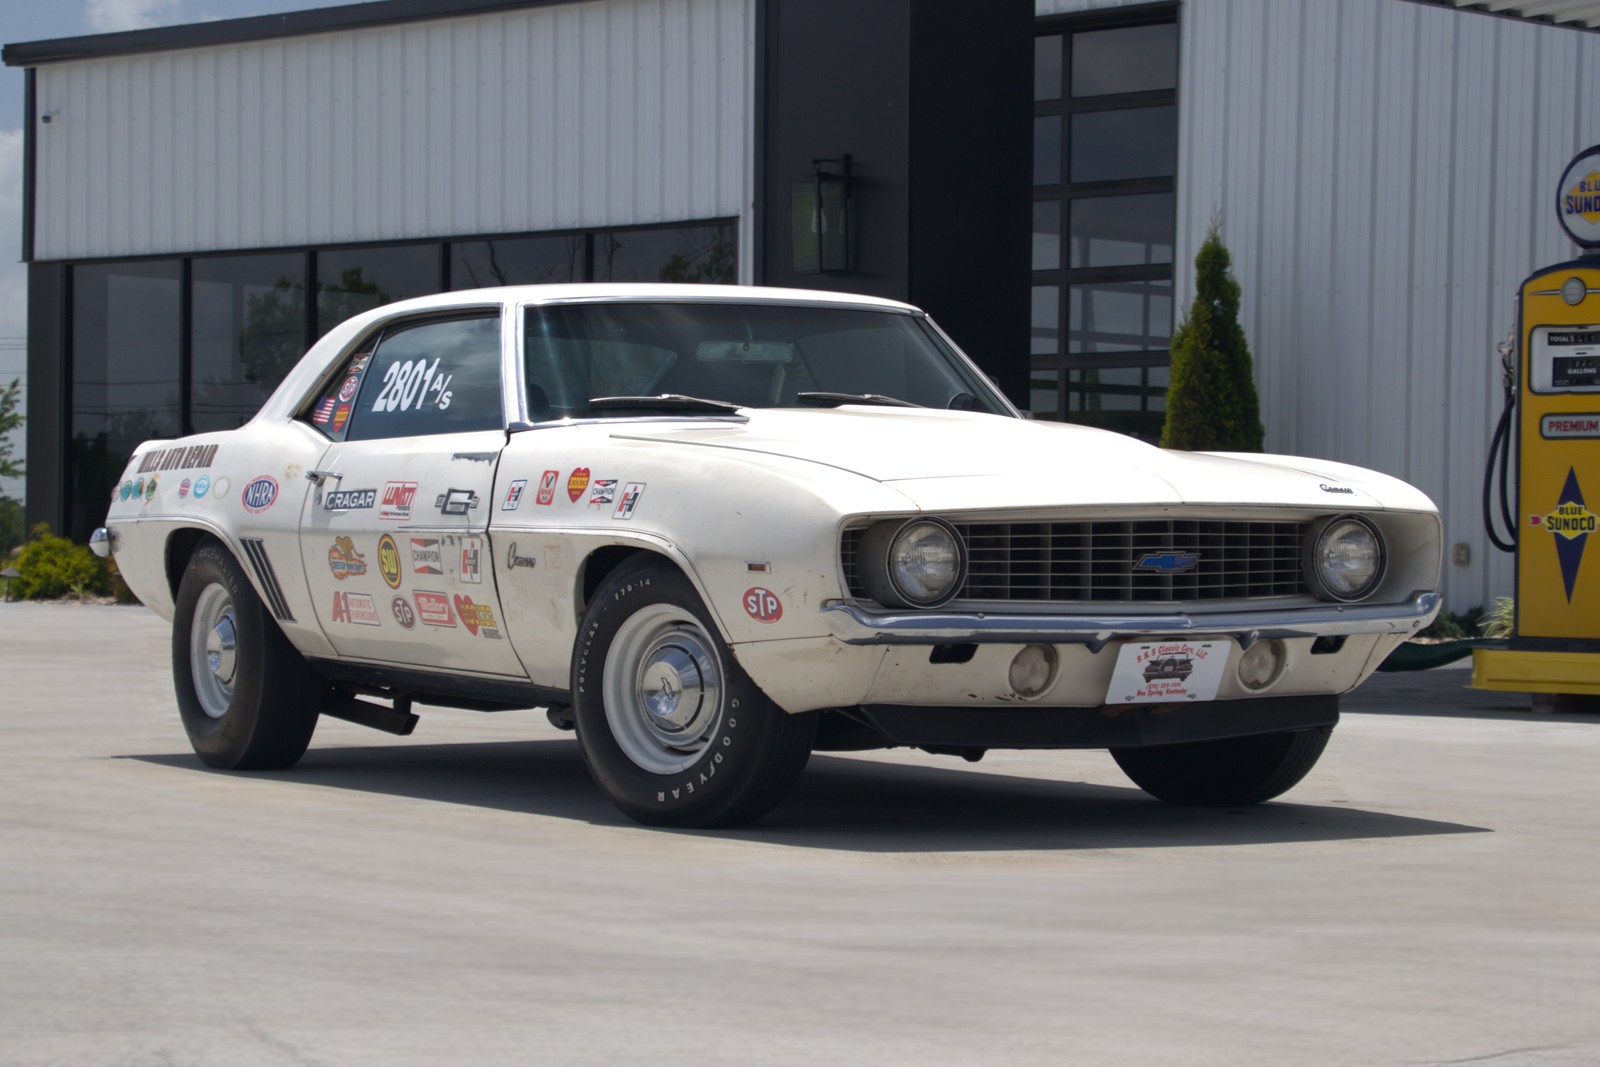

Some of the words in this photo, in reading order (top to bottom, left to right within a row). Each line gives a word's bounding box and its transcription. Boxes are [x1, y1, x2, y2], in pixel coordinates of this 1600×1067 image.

[1580, 181, 1600, 192] BLU
[1566, 196, 1600, 214] SUNO
[342, 378, 357, 397] STP
[371, 358, 441, 412] 2801
[1548, 420, 1599, 432] PREMIUM
[159, 446, 188, 471] AUTO
[180, 444, 219, 469] REPAIR
[246, 481, 275, 507] NHRA
[326, 491, 375, 509] CRAGAR
[591, 487, 615, 496] CHAMPION
[1558, 506, 1584, 516] BLUE
[1547, 515, 1596, 531] SUNOCO
[381, 549, 398, 574] SW
[412, 549, 440, 563] CHAMPION
[614, 578, 651, 601] F70-14
[394, 600, 413, 624] STP
[418, 597, 449, 614] Mallory
[747, 589, 778, 618] STP
[579, 621, 599, 693] POLYGLAS
[1137, 655, 1143, 663] S
[1144, 651, 1150, 660] &
[1151, 648, 1156, 656] S
[1158, 644, 1180, 654] Classic
[1181, 643, 1194, 655] Cars,
[1196, 648, 1208, 660] LLC
[657, 698, 740, 802] GOODYEAR
